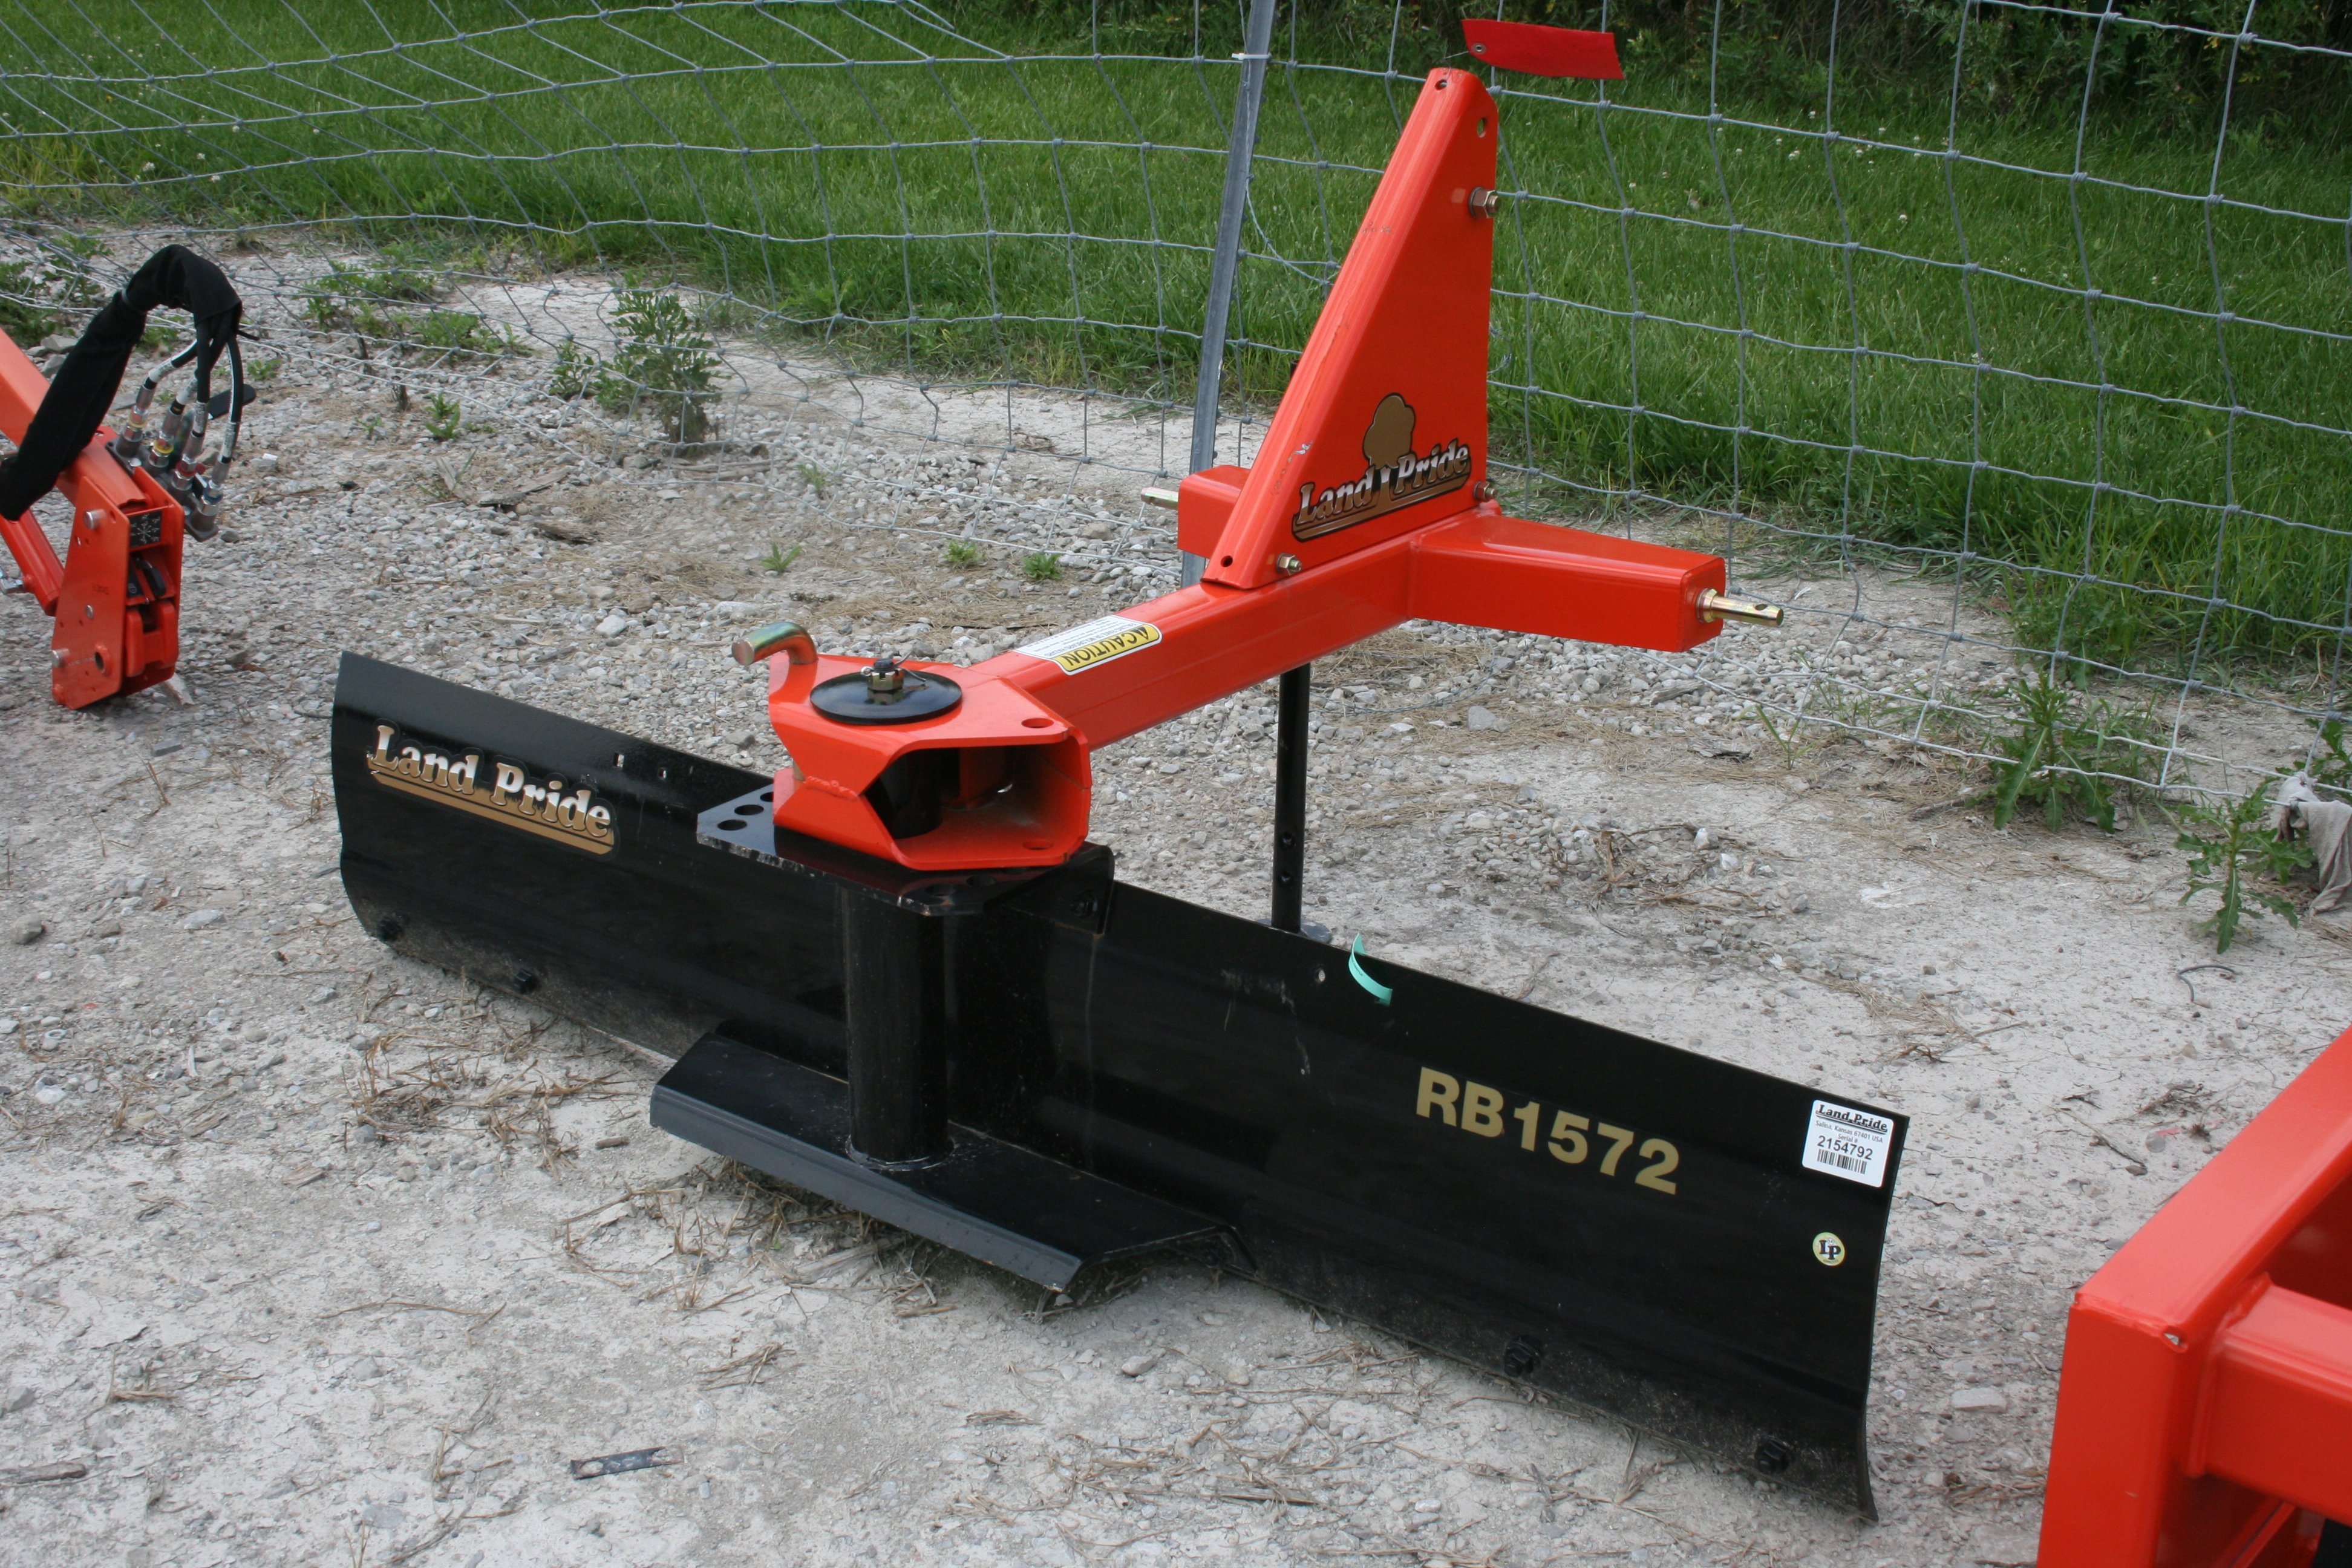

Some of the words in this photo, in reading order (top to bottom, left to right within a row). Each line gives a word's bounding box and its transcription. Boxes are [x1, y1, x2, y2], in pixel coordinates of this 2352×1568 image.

[1295, 463, 1376, 526] Land
[1393, 437, 1469, 494] Pride
[1063, 633, 1137, 666] CAUTION
[370, 725, 479, 795] Land
[490, 762, 611, 837] Pride
[1416, 1067, 1680, 1195] RB1572
[1818, 1104, 1851, 1120] Land
[1853, 1113, 1887, 1131] Pride
[1834, 1125, 1853, 1135] Kansas
[1854, 1130, 1870, 1140] 67401
[1838, 1134, 1853, 1142] Serial
[1817, 1135, 1873, 1160] 2154792
[1819, 1239, 1841, 1260] LP
